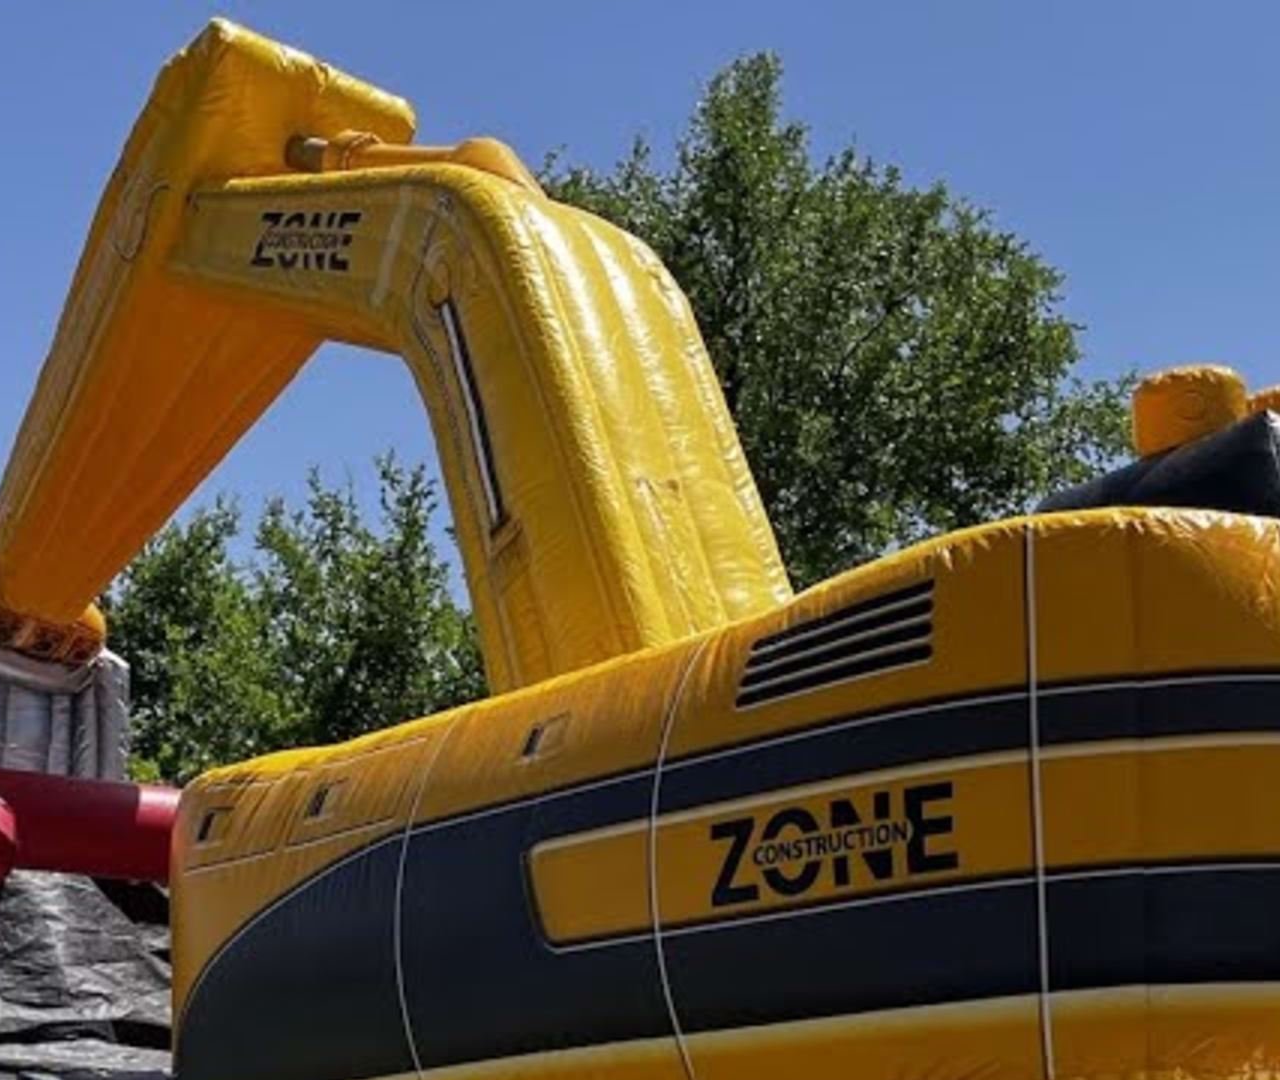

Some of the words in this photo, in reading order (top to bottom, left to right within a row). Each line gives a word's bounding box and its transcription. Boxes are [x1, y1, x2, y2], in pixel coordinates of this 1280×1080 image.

[250, 211, 362, 271] ZONE
[710, 781, 959, 908] ZONE
[752, 820, 908, 867] CONSTRUCTION
